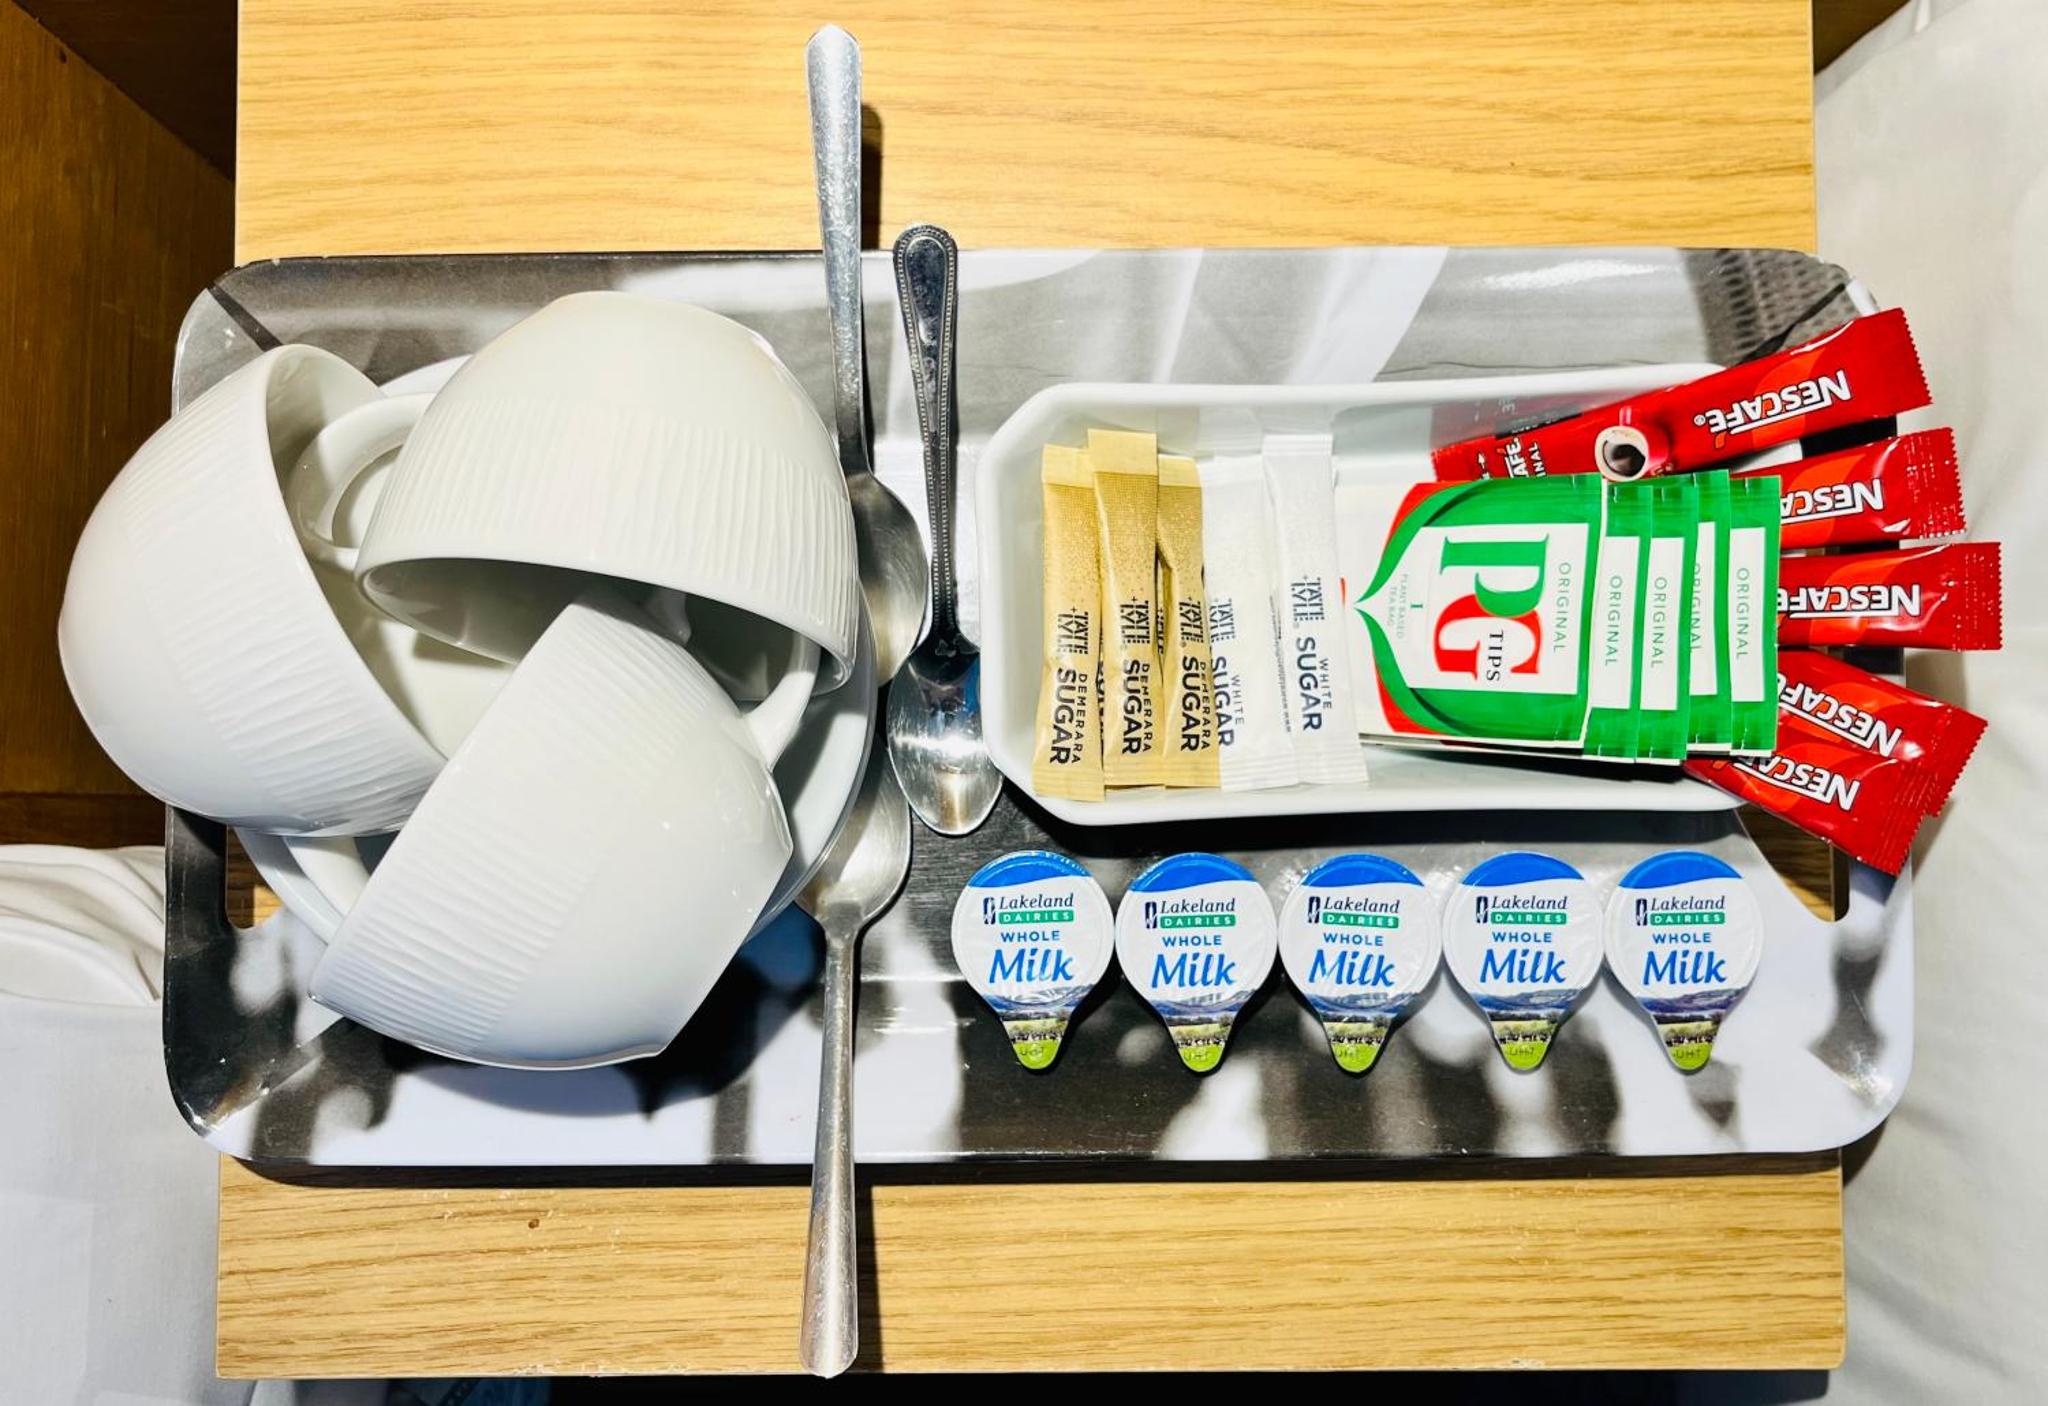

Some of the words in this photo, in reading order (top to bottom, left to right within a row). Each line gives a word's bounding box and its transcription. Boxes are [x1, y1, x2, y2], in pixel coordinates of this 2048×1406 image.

[1780, 478, 1885, 527] NESCA
[1218, 597, 1236, 640] TATE
[1306, 577, 1326, 621] TATE
[1553, 562, 1571, 653] ORIGINAL
[1737, 567, 1751, 660] ORIGINAL
[1074, 611, 1089, 655] TATE
[1134, 600, 1151, 644] TATE
[1191, 600, 1205, 643] TATE
[1605, 575, 1623, 667] ORIGINAL
[1650, 577, 1668, 669] ORIGINAL
[1486, 629, 1504, 682] TIPS
[1180, 656, 1201, 752] SUGAR
[1212, 656, 1235, 746] SUGAR
[1230, 674, 1245, 726] WHITE
[1295, 636, 1323, 731] SUGAR
[1319, 657, 1332, 709] WHITE
[1049, 667, 1077, 765] SUGAR
[1071, 673, 1088, 763] DEMERARA
[1122, 659, 1143, 755] SUGAR
[1140, 663, 1153, 752] DEMERARA
[1199, 661, 1211, 750] DEMERARA
[999, 893, 1074, 909] Lakeland
[1002, 911, 1071, 923] DAIRIES
[1160, 897, 1236, 914] Lakeland
[1163, 915, 1232, 927] DAIRIES
[1324, 896, 1400, 914] Lakeland
[1326, 914, 1396, 927] DAIRIES
[1491, 895, 1567, 912] Lakeland
[1494, 913, 1563, 924] DAIRIES
[1650, 895, 1725, 912] Lakeland
[1653, 913, 1722, 924] DAIRIES
[1001, 930, 1061, 943] WHOLE
[1162, 935, 1223, 948] WHOLE
[1323, 933, 1384, 946] WHOLE
[1492, 931, 1553, 943] WHOLE
[1652, 931, 1712, 943] WHOLE
[989, 948, 1073, 984] Milk
[1151, 953, 1237, 989] Milk
[1308, 949, 1395, 987] Milk
[1479, 947, 1566, 984] Milk
[1643, 947, 1726, 985] Milk
